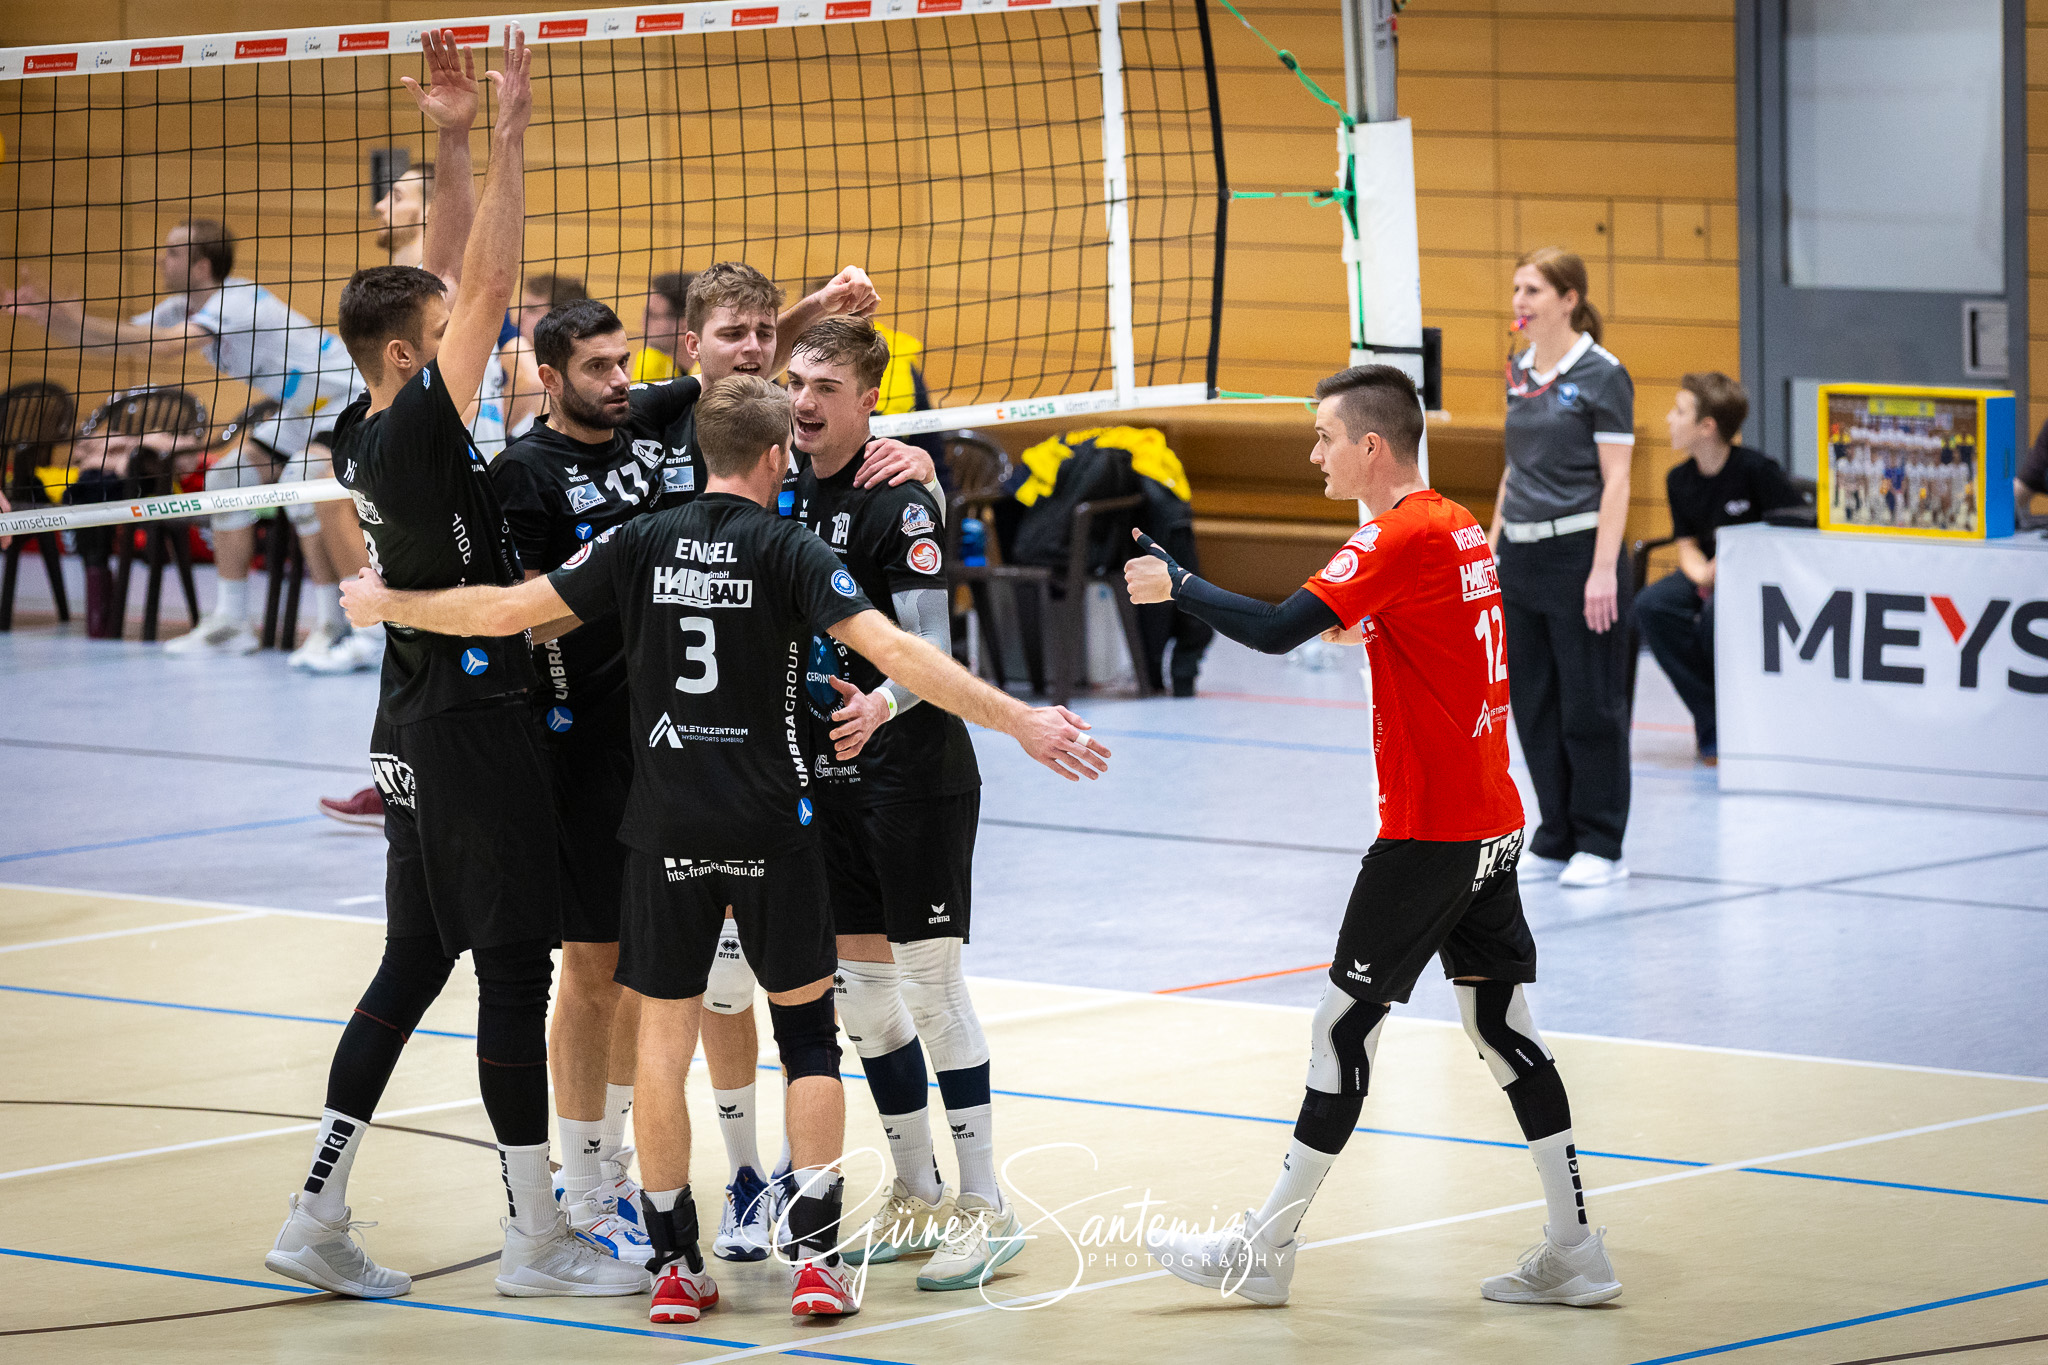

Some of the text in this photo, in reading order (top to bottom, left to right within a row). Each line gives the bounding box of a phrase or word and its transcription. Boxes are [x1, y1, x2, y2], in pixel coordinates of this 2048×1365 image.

[1010, 402, 1056, 419] FUCHS
[665, 454, 692, 464] erima
[605, 460, 650, 506] 17
[147, 488, 299, 517] FUCHS Ideen umsetzen
[10, 514, 68, 531] umsetzen
[1474, 604, 1508, 685] 12
[675, 616, 719, 694] 3
[784, 641, 809, 787] UMBRAGROUP
[666, 862, 765, 882] hts-frankenbau.de
[928, 914, 950, 924] erima
[1346, 970, 1372, 984] erima
